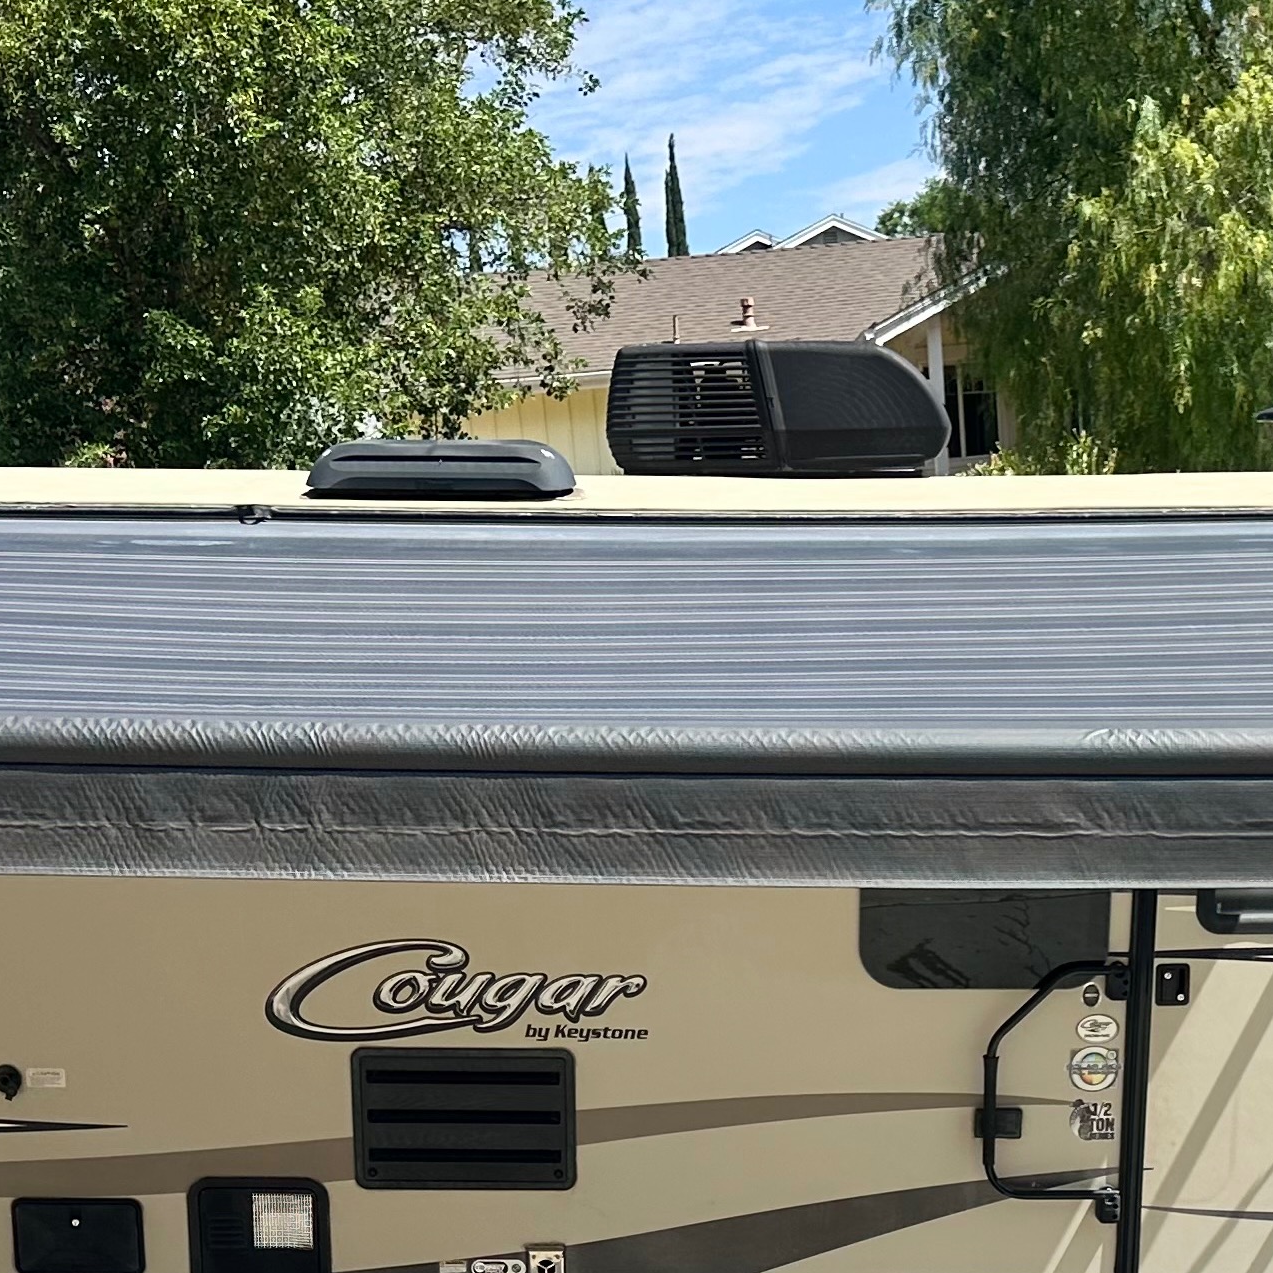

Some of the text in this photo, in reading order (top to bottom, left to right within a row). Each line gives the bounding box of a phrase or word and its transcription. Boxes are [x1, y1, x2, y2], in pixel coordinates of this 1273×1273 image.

[265, 938, 647, 1042] Cougar
[525, 1024, 649, 1042] by Keystone
[1091, 1102, 1112, 1117] 1/2
[1090, 1118, 1115, 1131] TON
